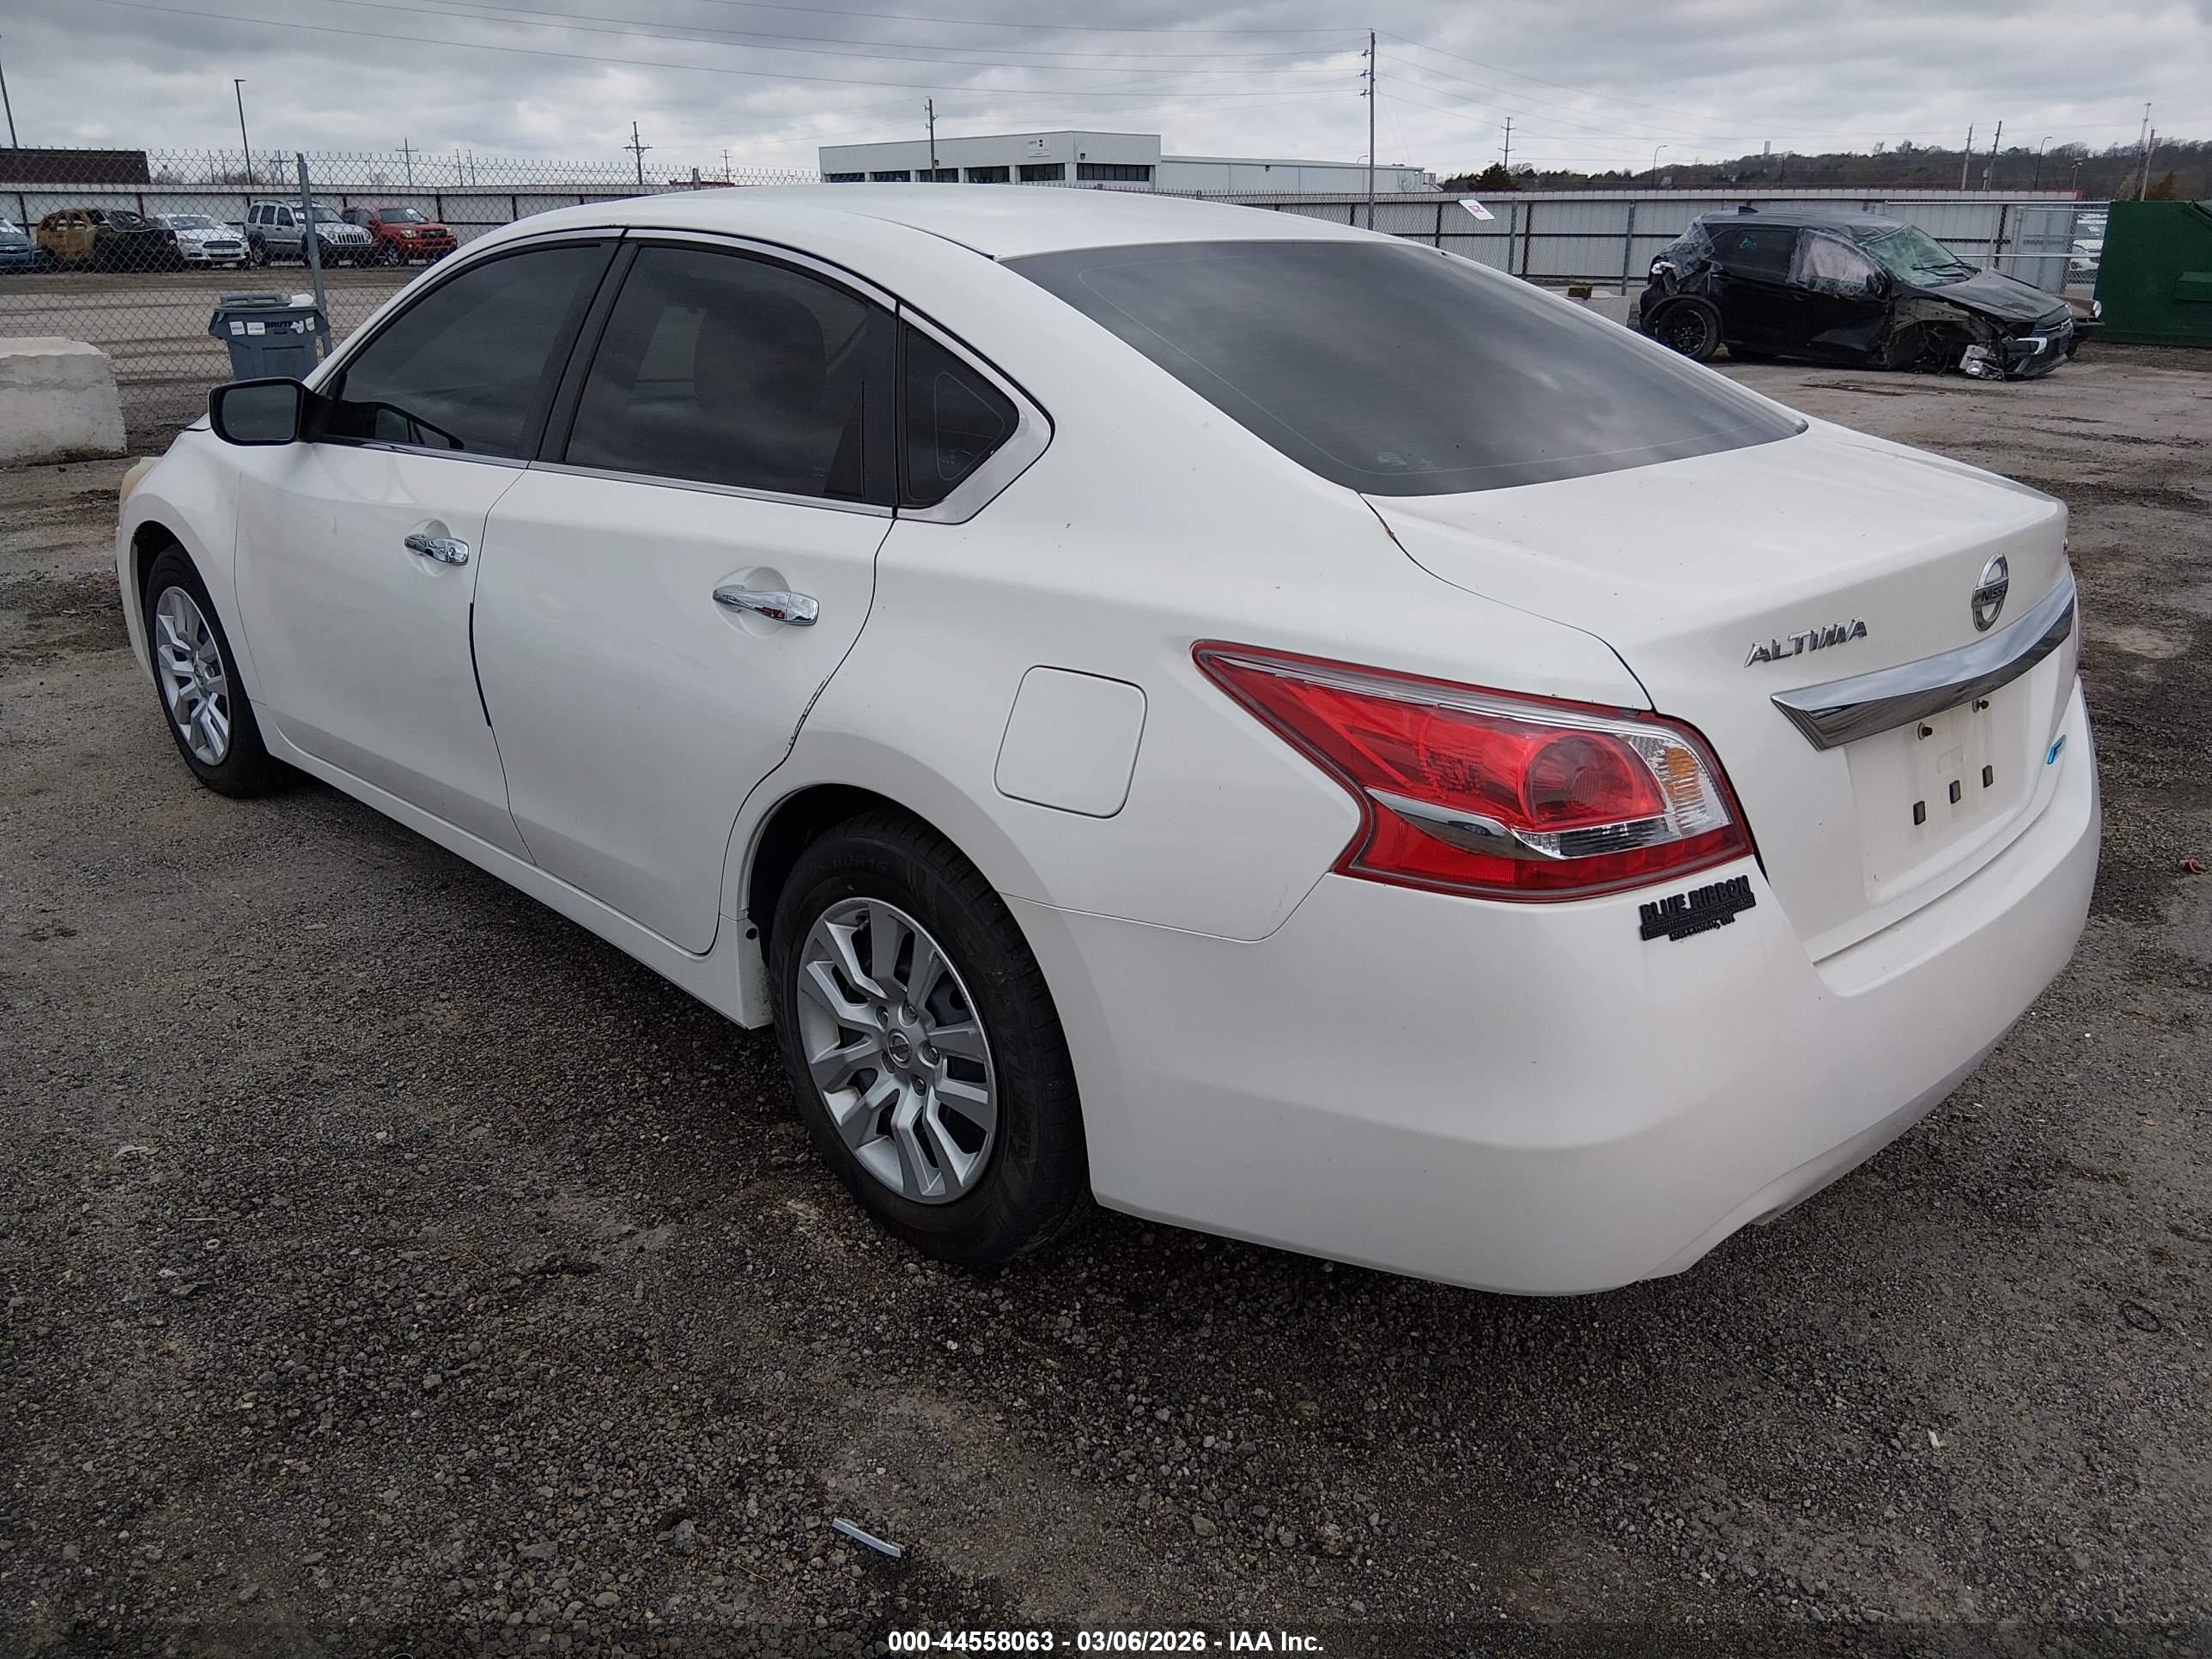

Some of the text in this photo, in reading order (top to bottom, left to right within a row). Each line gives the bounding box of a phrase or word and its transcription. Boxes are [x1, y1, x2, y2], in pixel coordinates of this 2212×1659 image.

[1744, 617, 1868, 667] ALTIMA
[1639, 893, 1686, 926] BLUE
[1688, 875, 1751, 908] RIBBON
